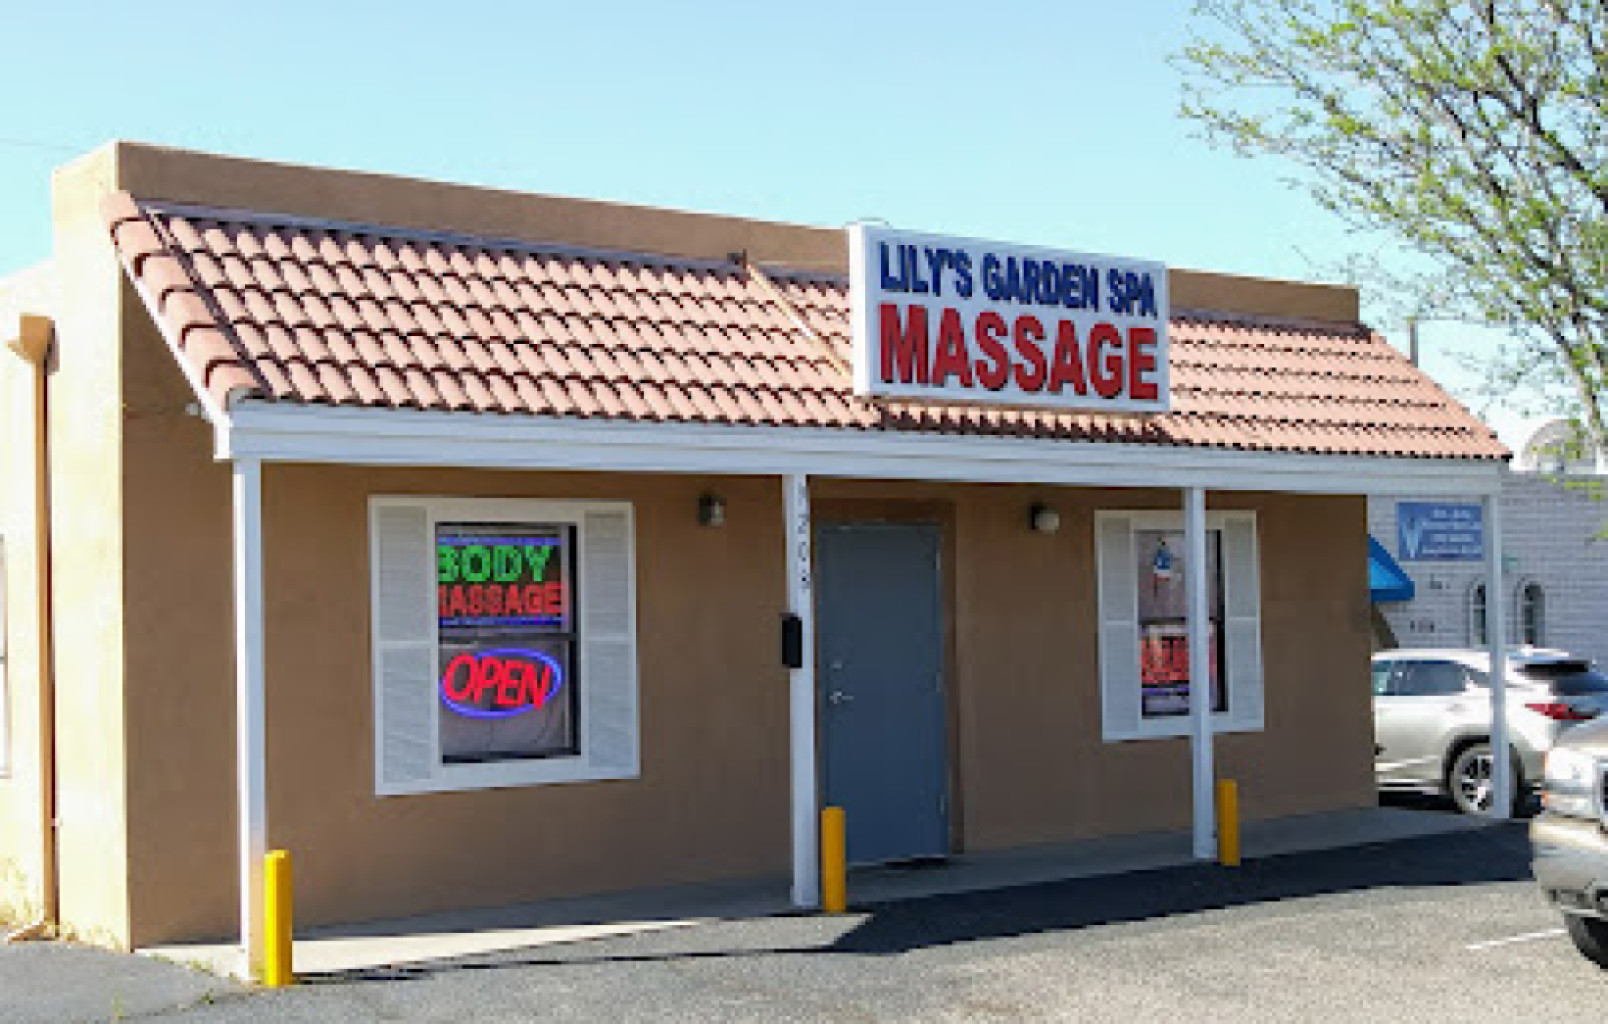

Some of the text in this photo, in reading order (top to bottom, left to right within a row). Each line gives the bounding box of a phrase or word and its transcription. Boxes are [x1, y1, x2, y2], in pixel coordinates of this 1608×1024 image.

[879, 241, 1158, 319] LILY'S GARDEN SPA
[878, 304, 1159, 400] MASSAGE
[437, 545, 552, 581] BODY
[444, 653, 552, 711] OPEN
